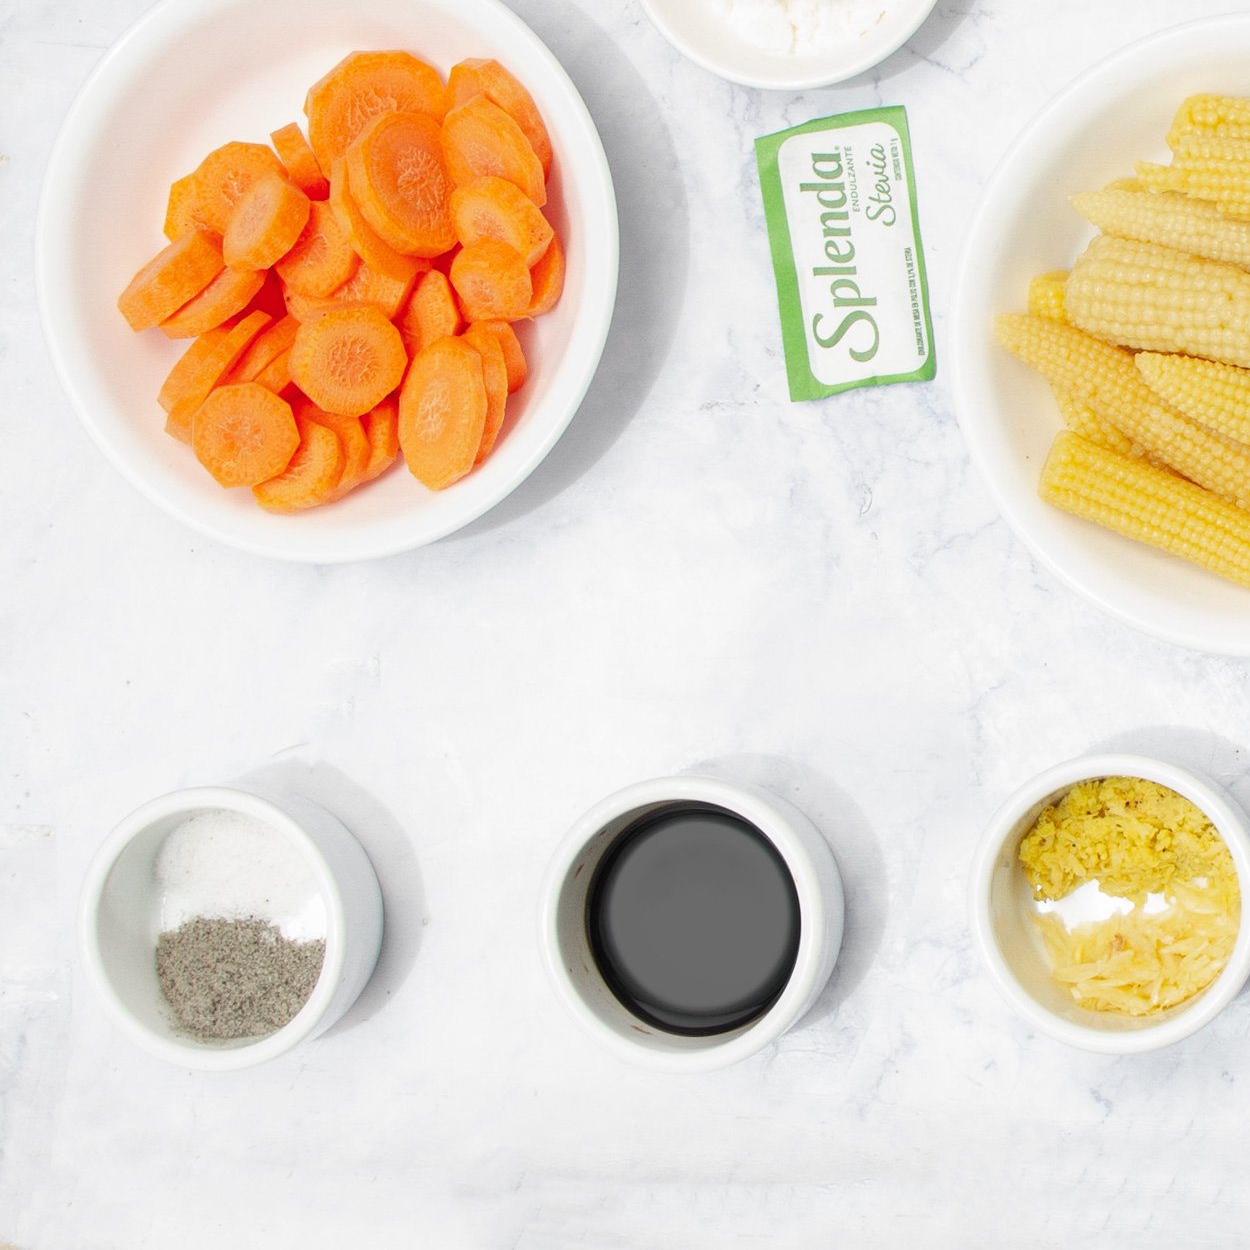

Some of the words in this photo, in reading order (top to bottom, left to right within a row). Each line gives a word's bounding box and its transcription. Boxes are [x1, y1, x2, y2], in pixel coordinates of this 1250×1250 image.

[844, 145, 860, 212] ENDULZANTE
[865, 143, 896, 227] Stevia
[800, 151, 880, 363] Splenda
